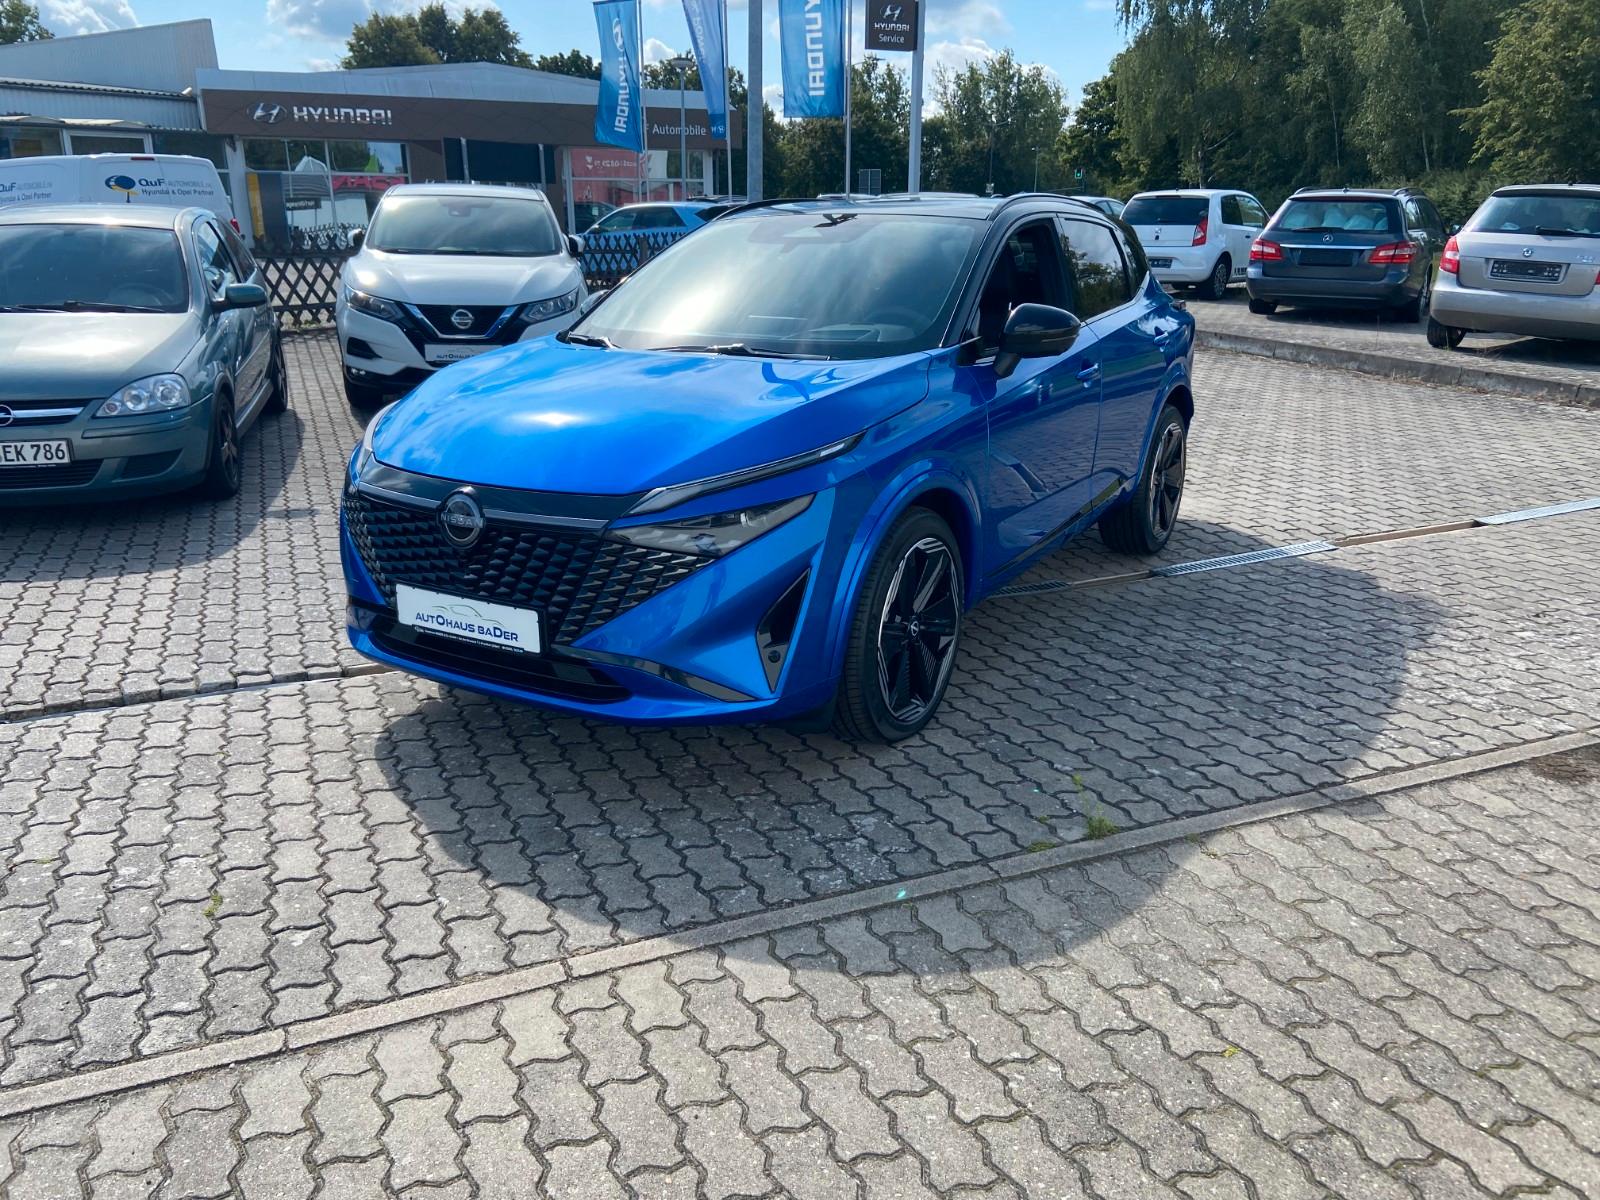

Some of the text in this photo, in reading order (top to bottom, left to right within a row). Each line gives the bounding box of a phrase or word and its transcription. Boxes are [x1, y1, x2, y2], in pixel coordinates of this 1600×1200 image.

[874, 22, 910, 32] HYUNDAI
[879, 33, 905, 43] Service
[293, 106, 393, 125] HYUNDAI
[30, 443, 66, 461] 786
[441, 512, 484, 528] NISSAN
[415, 611, 476, 633] AUTOHAUS
[477, 625, 519, 642] BADER
